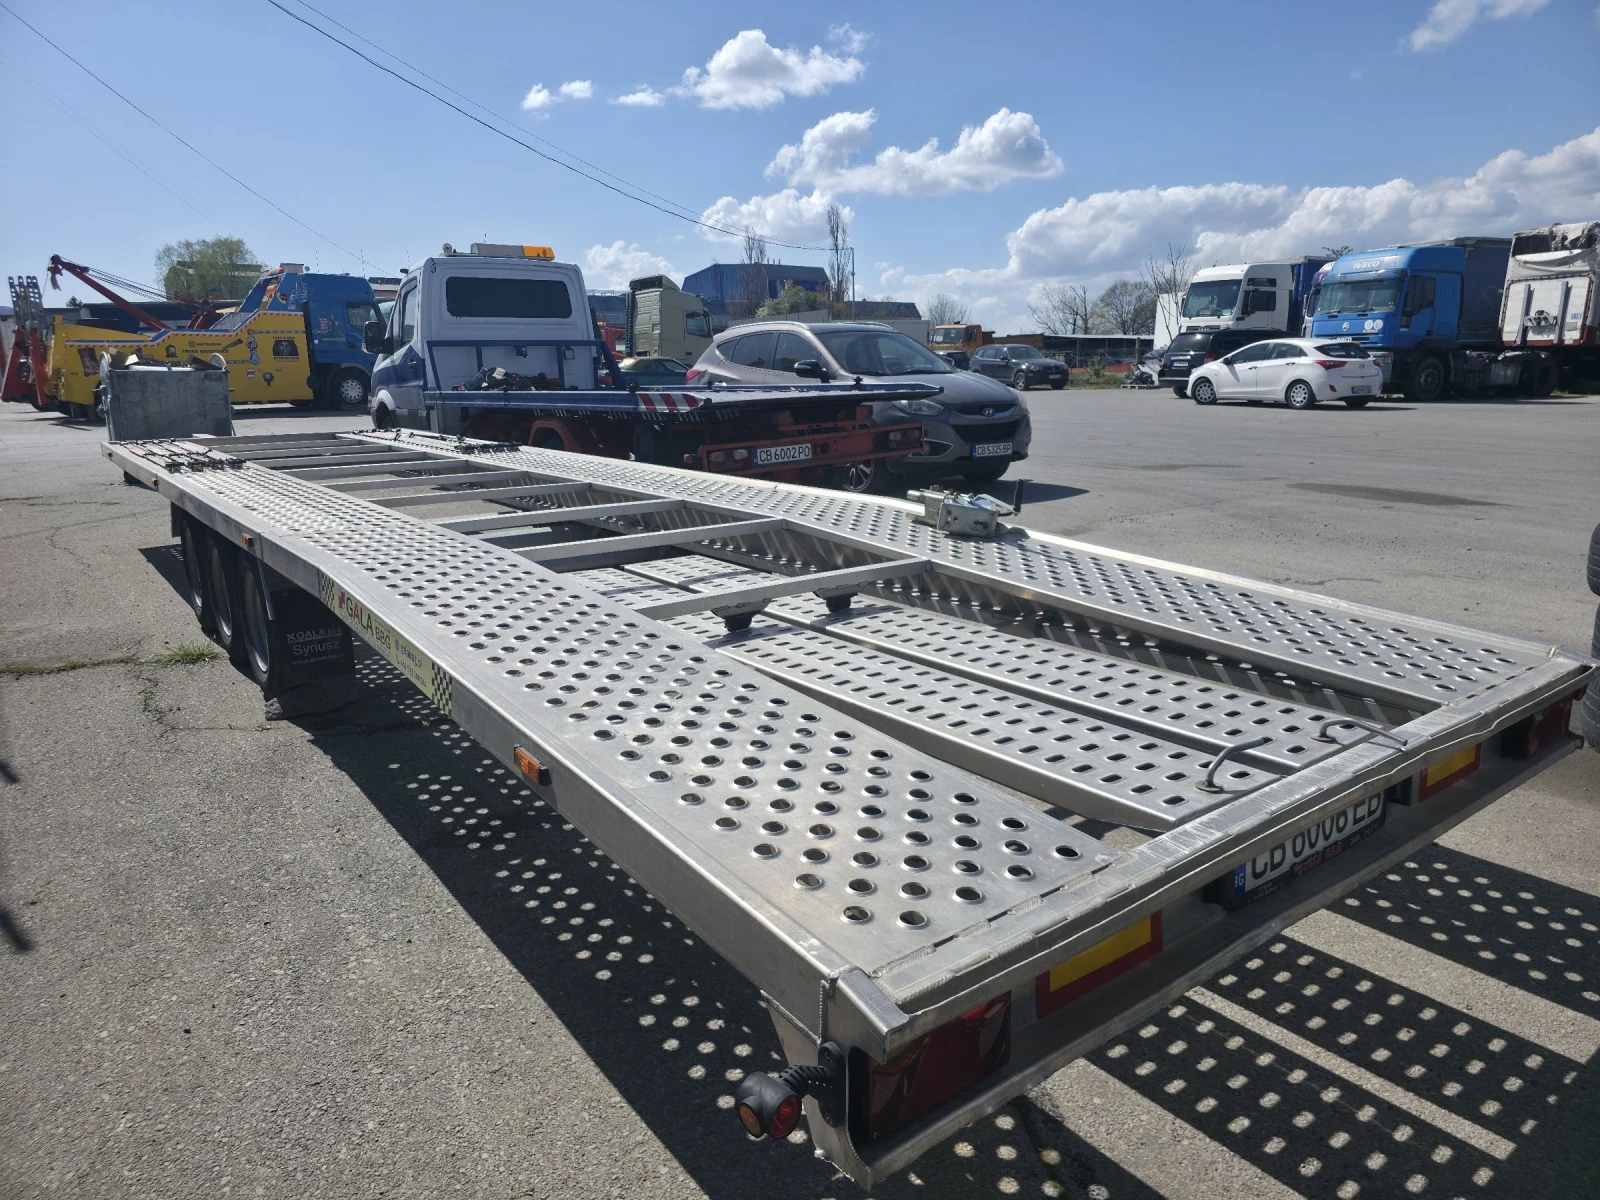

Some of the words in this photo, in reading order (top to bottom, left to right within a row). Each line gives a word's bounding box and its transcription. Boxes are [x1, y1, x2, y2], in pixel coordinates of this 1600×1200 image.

[1353, 260, 1380, 269] IVECO
[759, 449, 773, 462] CB
[774, 446, 798, 461] 6002
[798, 445, 810, 458] PO
[976, 445, 986, 456] CB
[346, 597, 374, 636] GALA
[375, 625, 392, 650] BBG
[292, 641, 341, 657] Syriusz
